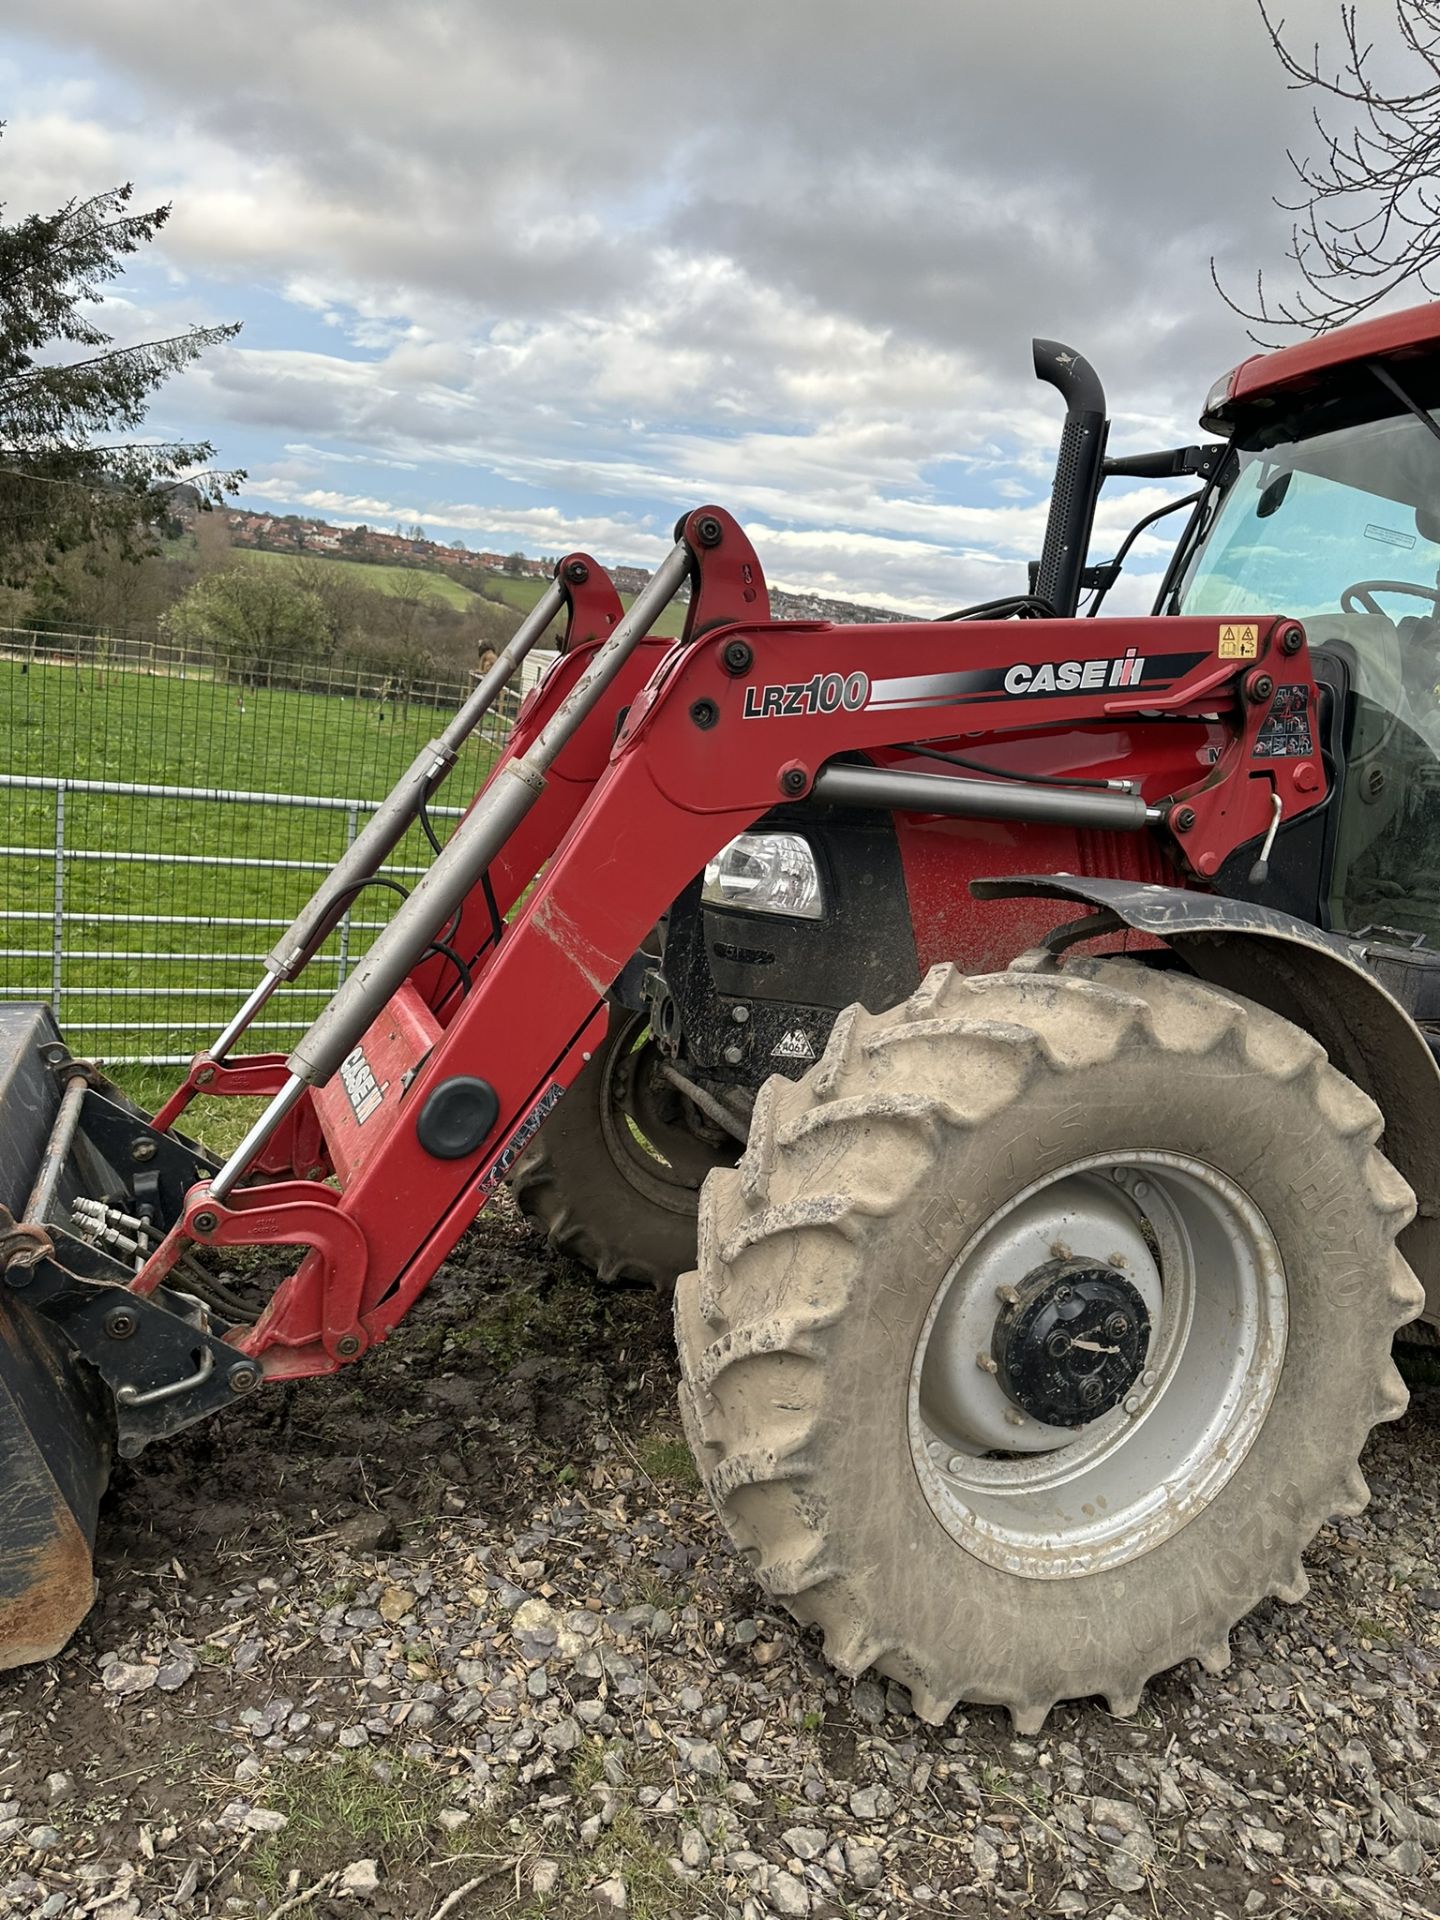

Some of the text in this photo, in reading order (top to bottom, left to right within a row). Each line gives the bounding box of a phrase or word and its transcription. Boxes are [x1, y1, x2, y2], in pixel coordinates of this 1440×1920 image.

[742, 670, 870, 719] LRZ100
[1004, 659, 1105, 695] CASE
[340, 1044, 378, 1107] CASE
